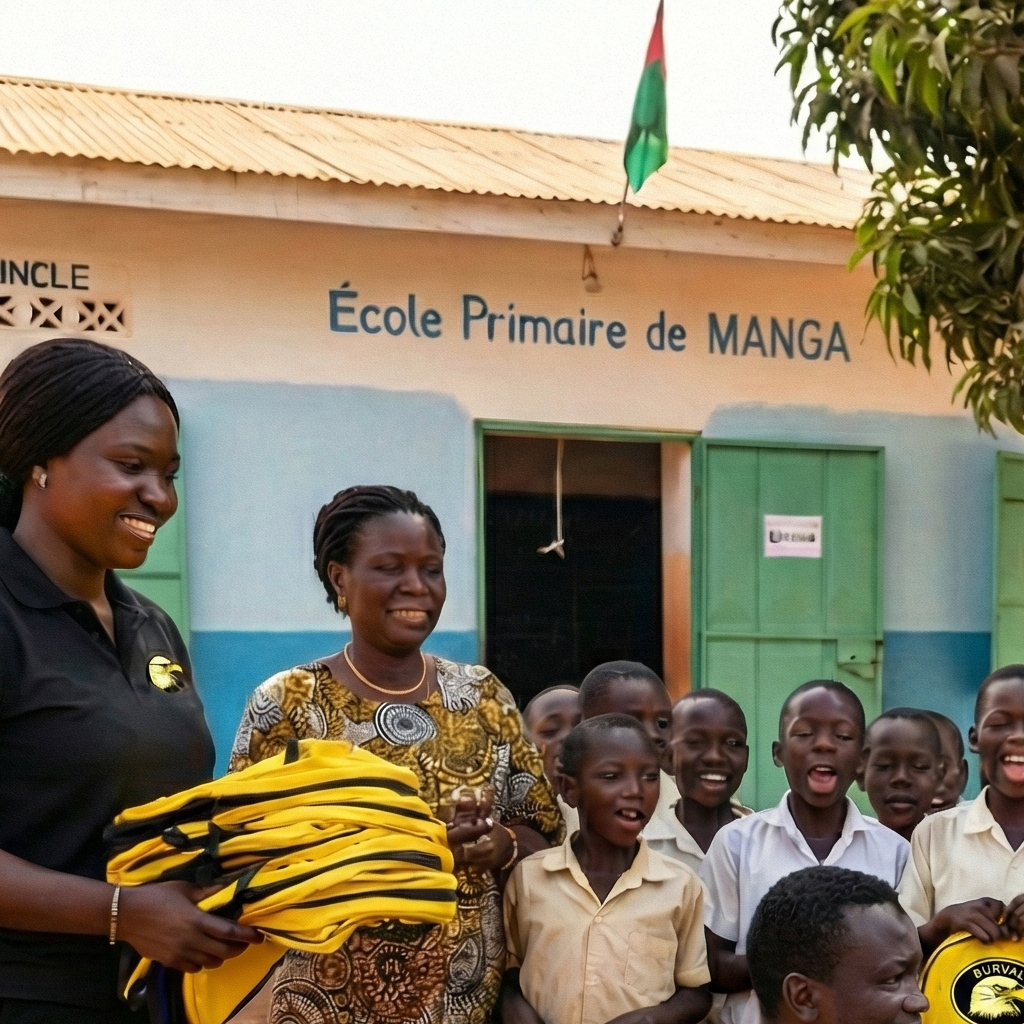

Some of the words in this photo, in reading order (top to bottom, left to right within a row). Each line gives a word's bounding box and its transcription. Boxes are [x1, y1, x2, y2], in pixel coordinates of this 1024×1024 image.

[328, 280, 443, 339] École
[462, 293, 628, 350] Primaire
[646, 309, 687, 352] de
[707, 311, 852, 363] MANGA
[972, 963, 1024, 981] BURVAL
